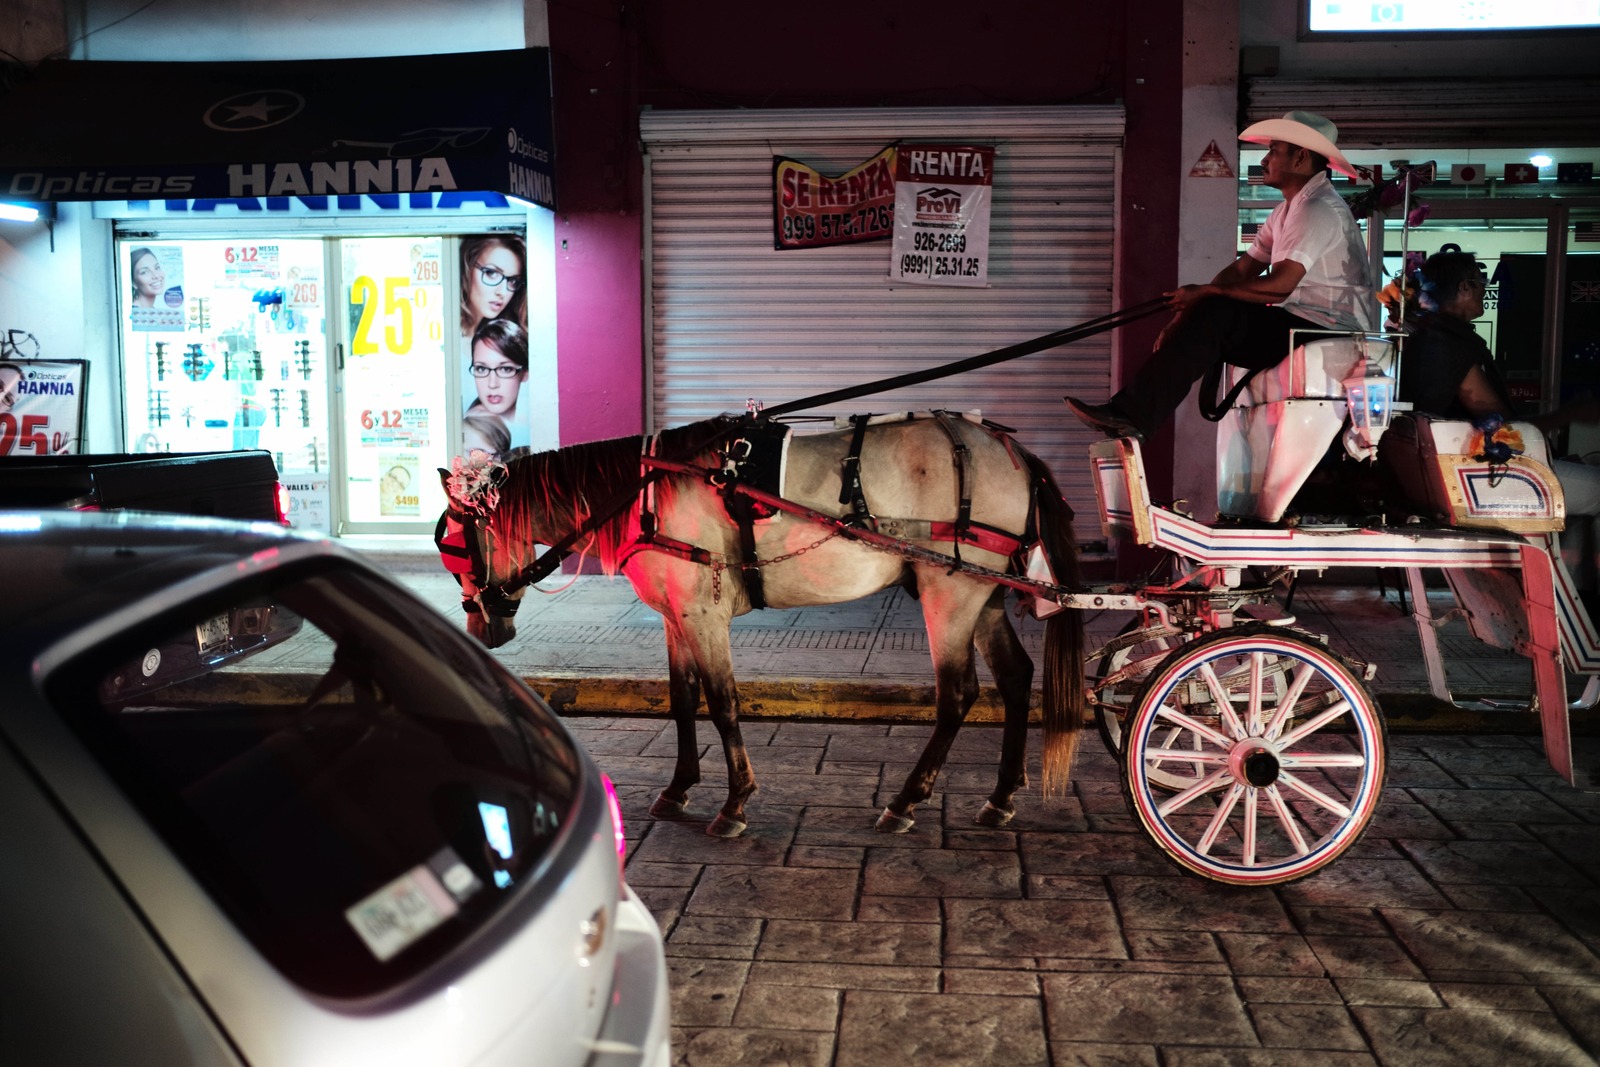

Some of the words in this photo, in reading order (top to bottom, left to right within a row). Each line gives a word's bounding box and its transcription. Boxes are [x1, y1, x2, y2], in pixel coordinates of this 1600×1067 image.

[910, 150, 985, 177] RENTA
[8, 171, 195, 200] Opticas
[226, 157, 458, 197] HANNIA
[508, 161, 554, 206] HANNIA
[781, 167, 811, 209] SE
[818, 157, 895, 208] RENTA
[782, 215, 816, 241] 999
[225, 247, 235, 263] 6
[241, 247, 258, 262] 12
[350, 275, 442, 356] 25%
[17, 380, 75, 396] HANNIA
[361, 409, 373, 430] 6
[381, 410, 403, 428] 12
[395, 495, 419, 506] $499
